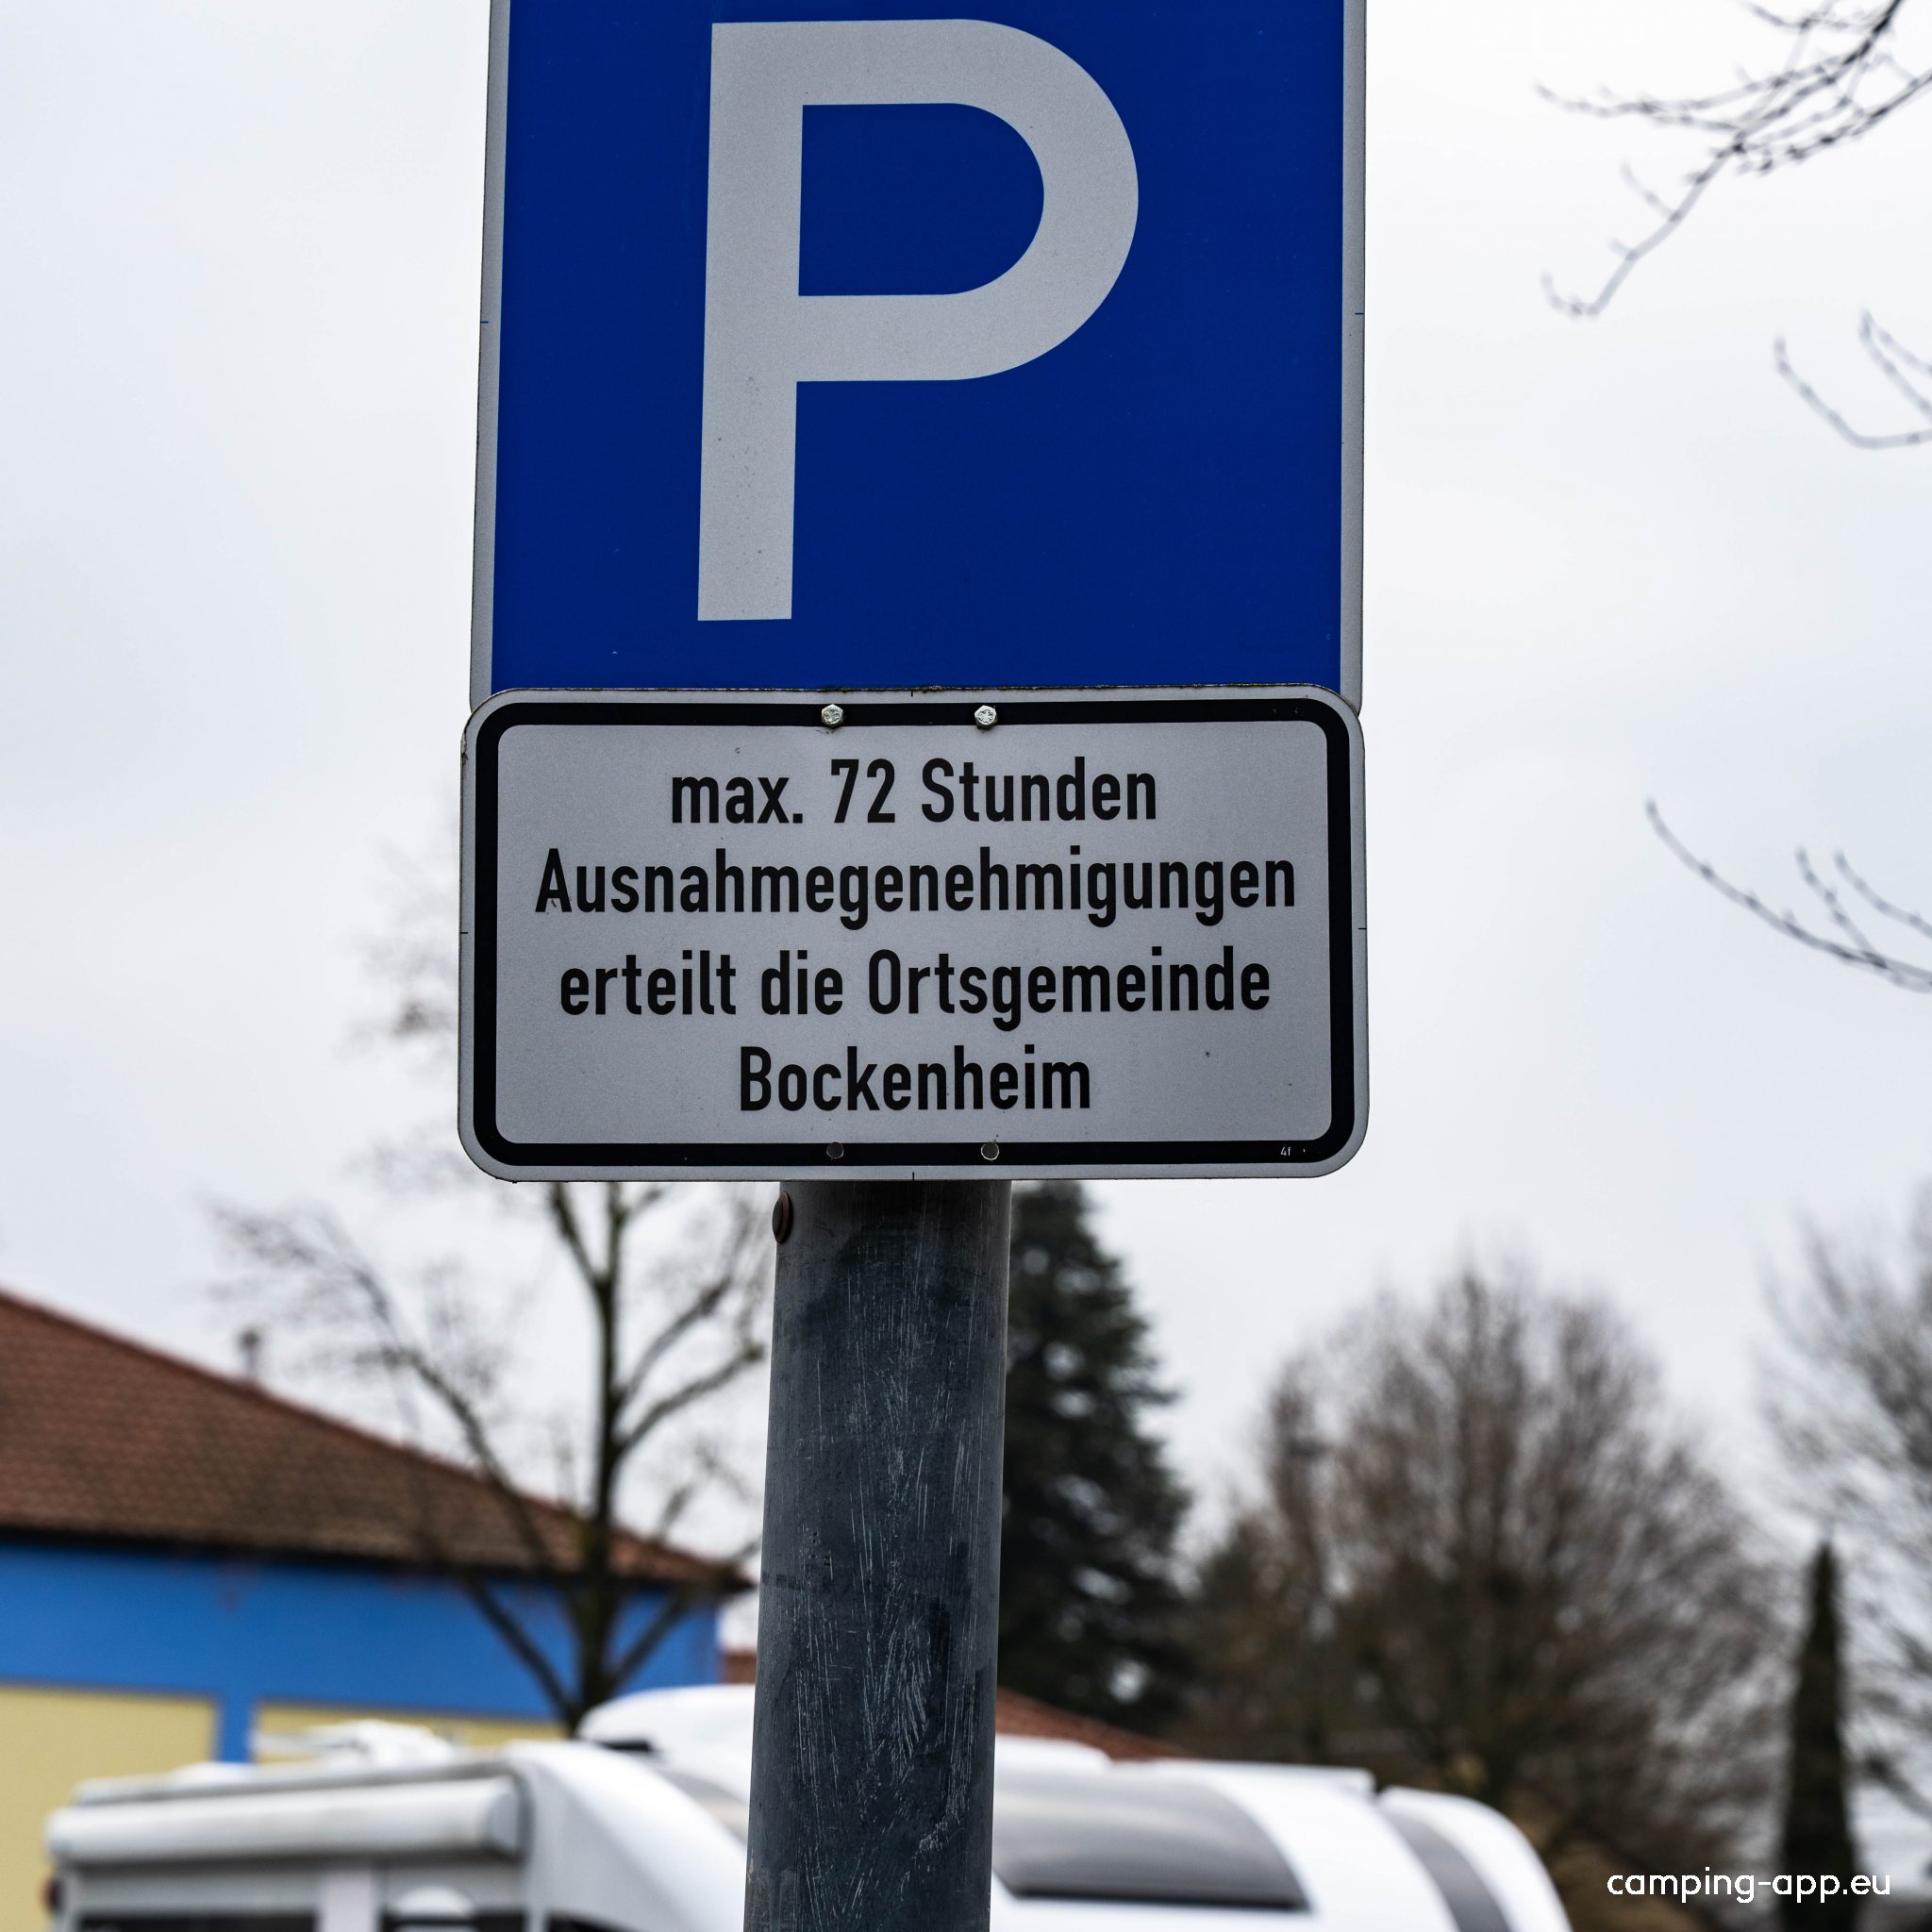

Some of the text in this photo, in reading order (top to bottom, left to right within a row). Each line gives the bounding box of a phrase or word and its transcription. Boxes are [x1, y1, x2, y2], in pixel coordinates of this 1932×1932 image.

[698, 19, 1139, 622] P
[672, 756, 1157, 824] max. 72 Stunden
[534, 844, 1295, 930] Ausnahmegenehmigungen
[558, 944, 1271, 1033] erteilt die Ortsgemeinde
[740, 1043, 1091, 1112] Bockenheim
